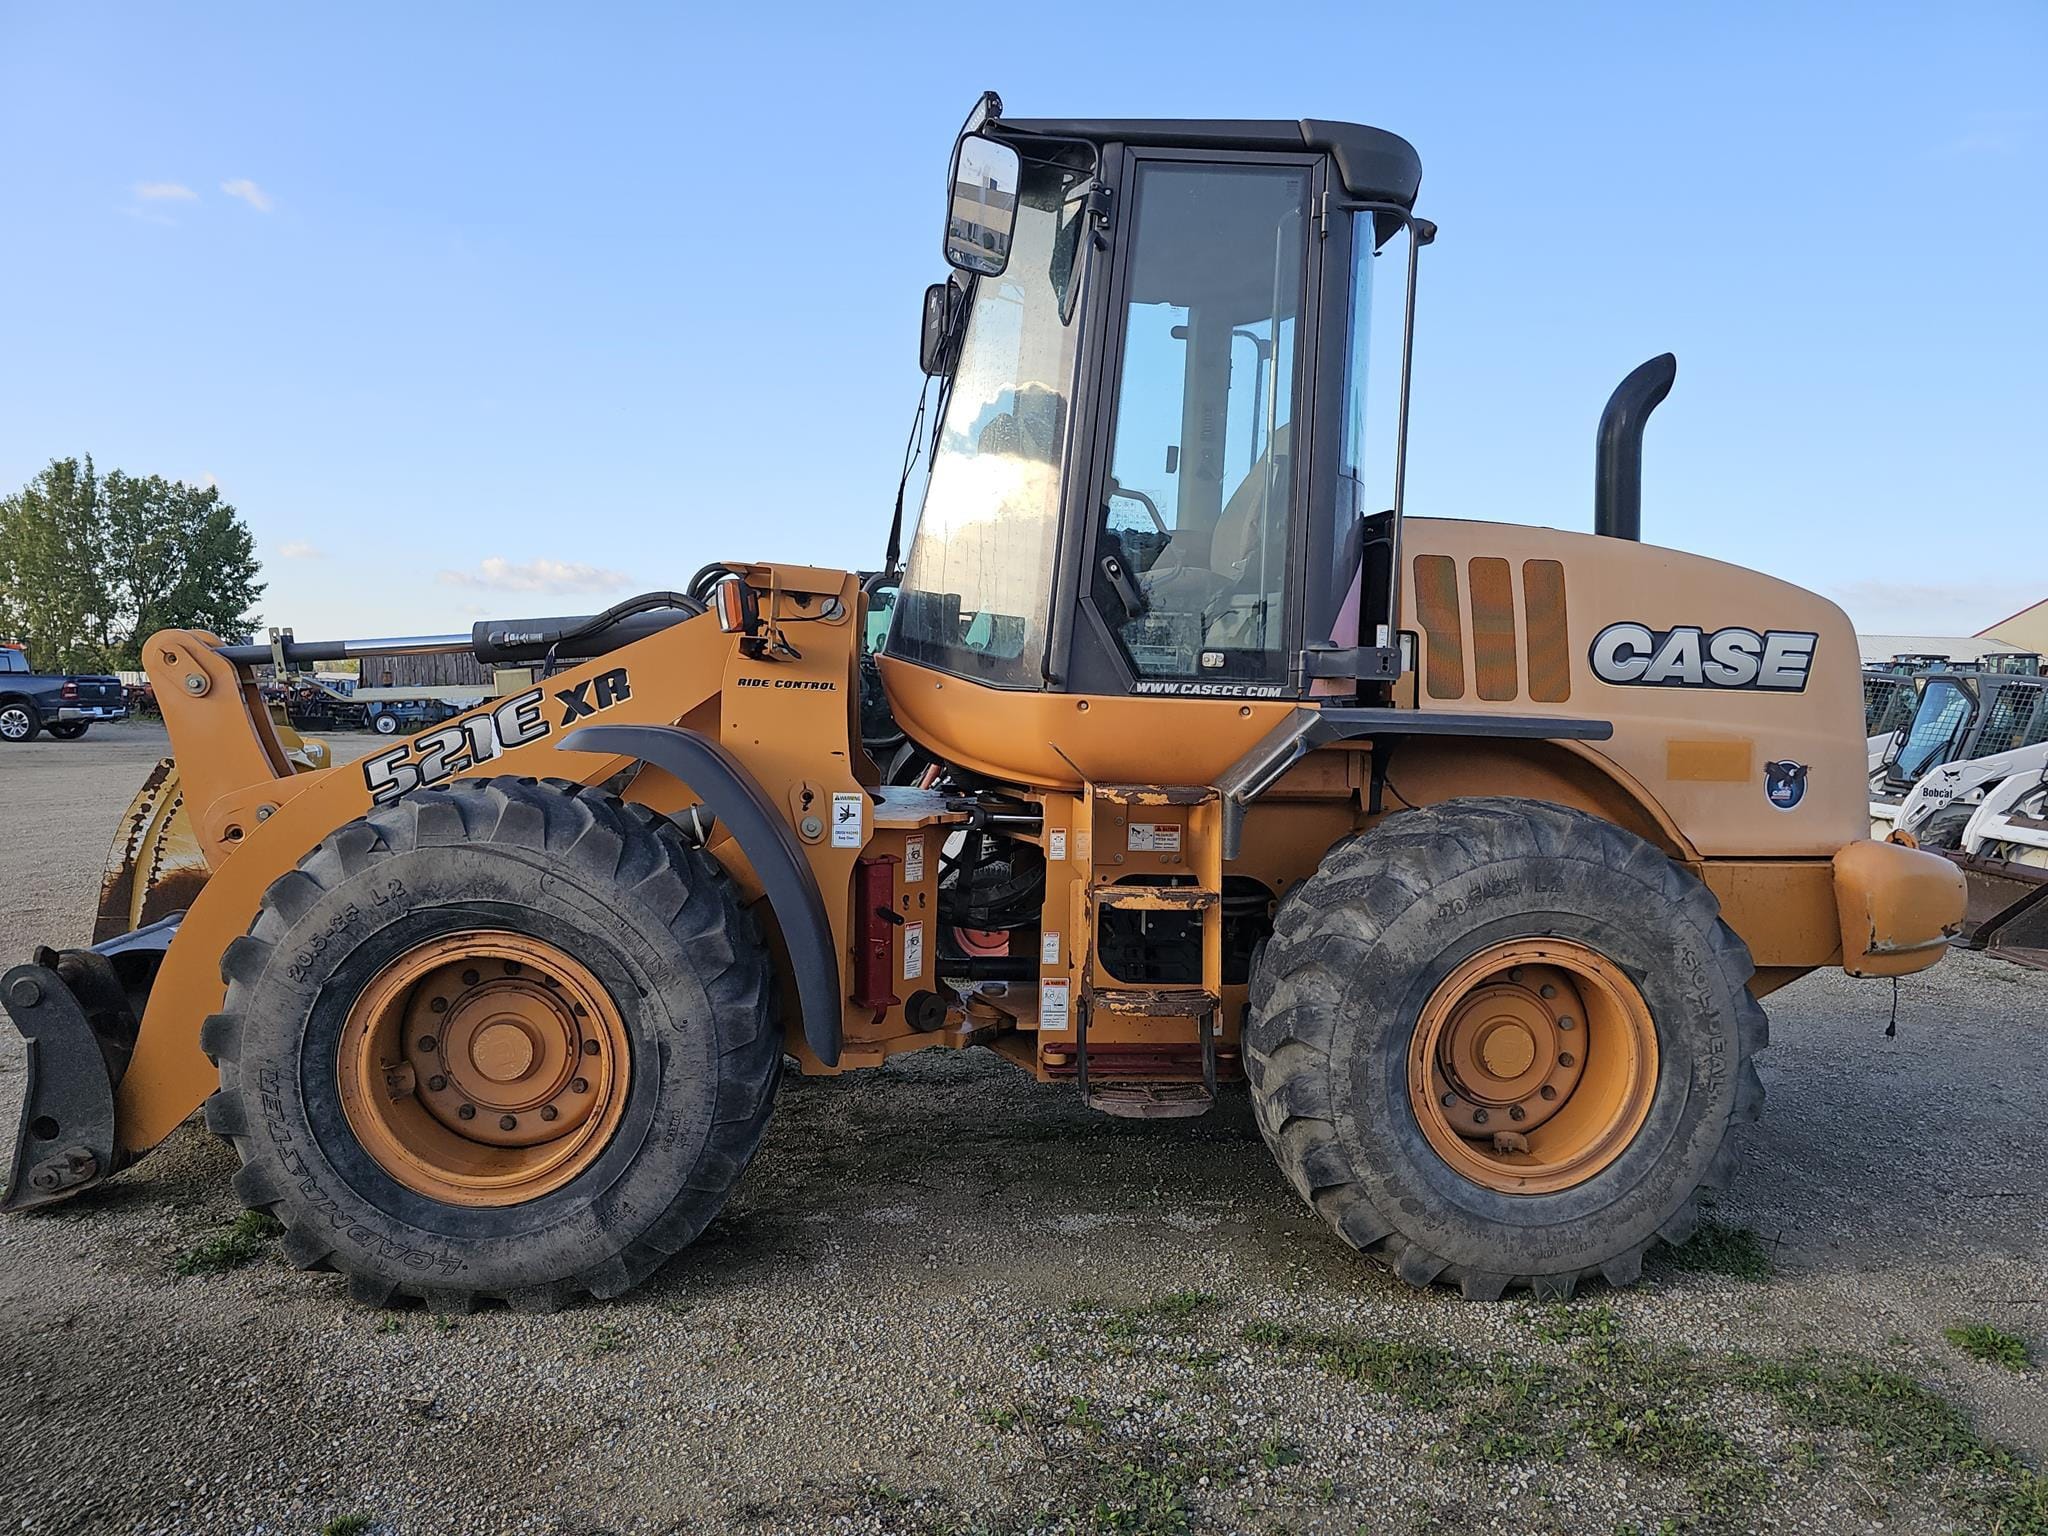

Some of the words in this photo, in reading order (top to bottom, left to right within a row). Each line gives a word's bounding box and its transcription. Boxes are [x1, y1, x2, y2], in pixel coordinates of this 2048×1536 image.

[1592, 624, 1817, 689] CASE
[737, 678, 771, 688] RIDE
[774, 680, 837, 691] CONTROL
[1136, 682, 1282, 697] WWW.CASECE.COM
[363, 688, 552, 806] 521E
[555, 668, 632, 727] XR
[1922, 787, 1953, 799] Bobcat
[259, 1067, 463, 1275] LOADMASTER
